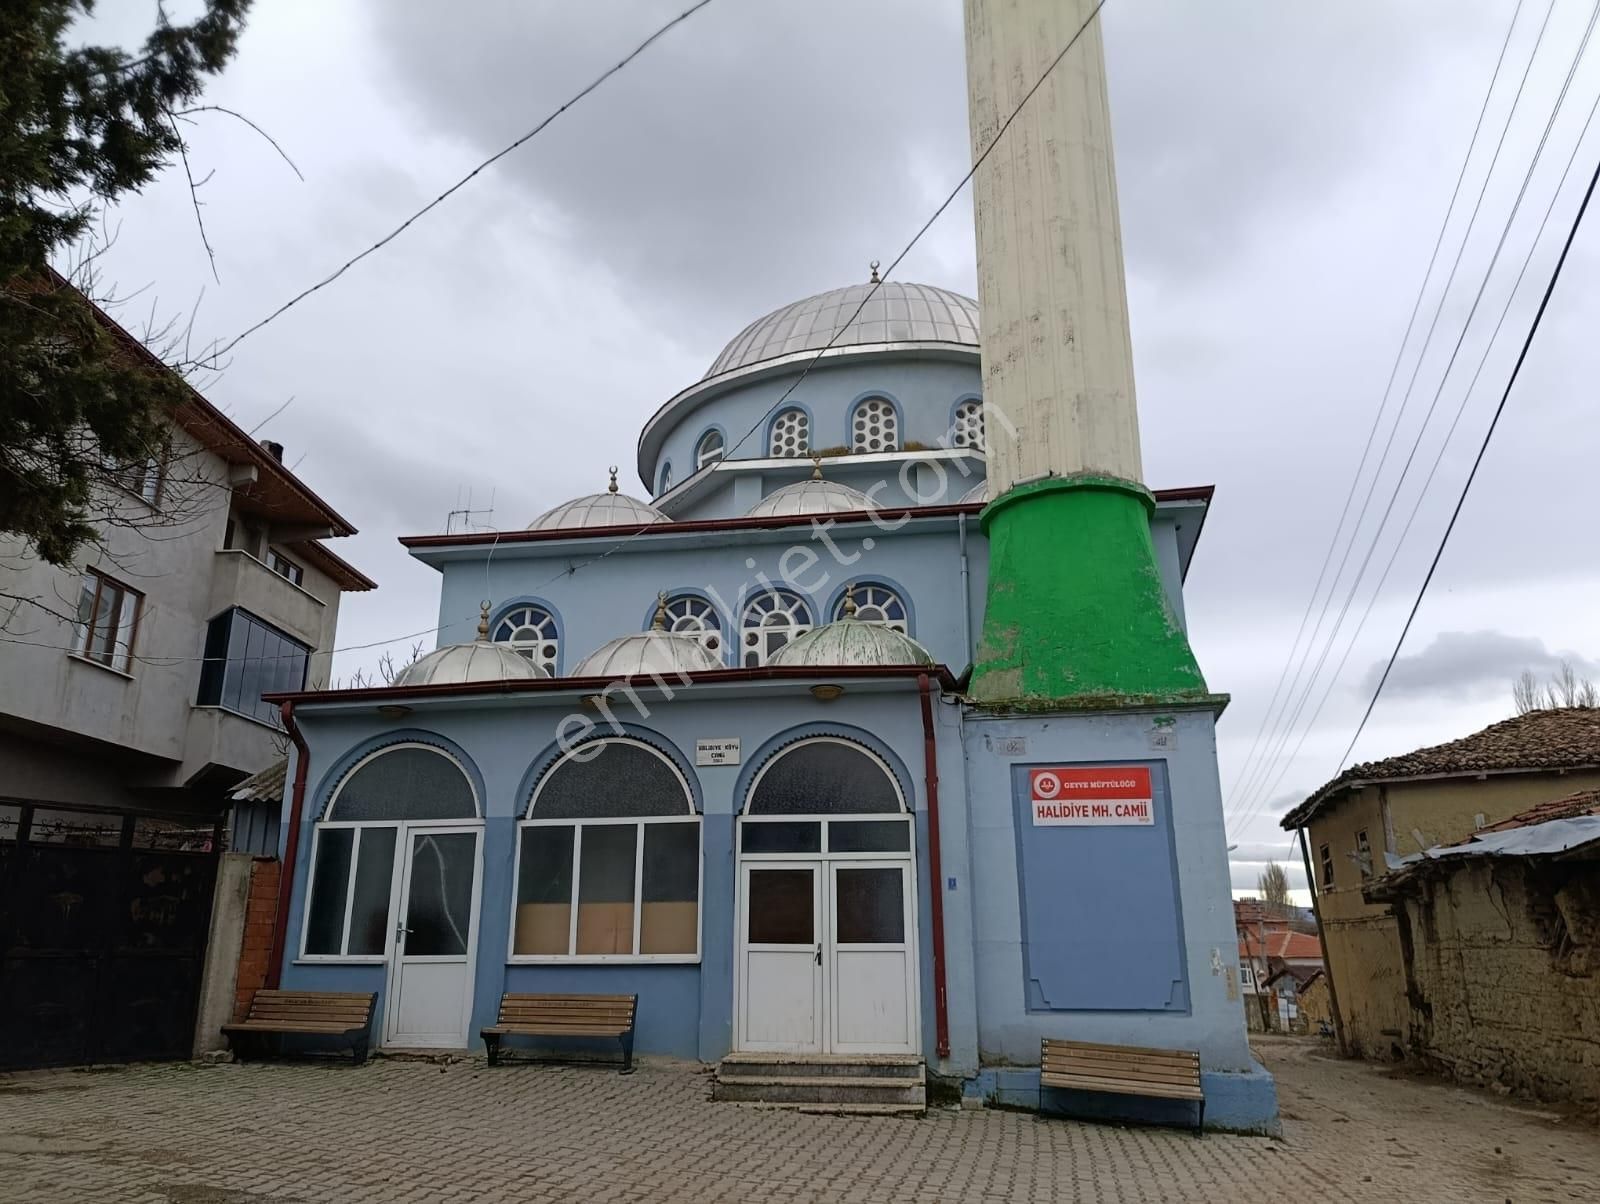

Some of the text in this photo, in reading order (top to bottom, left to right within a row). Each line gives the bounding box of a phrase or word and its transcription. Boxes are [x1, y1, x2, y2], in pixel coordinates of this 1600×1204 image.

[1037, 801, 1148, 818] HALİDİYE MH. CAMİİ
